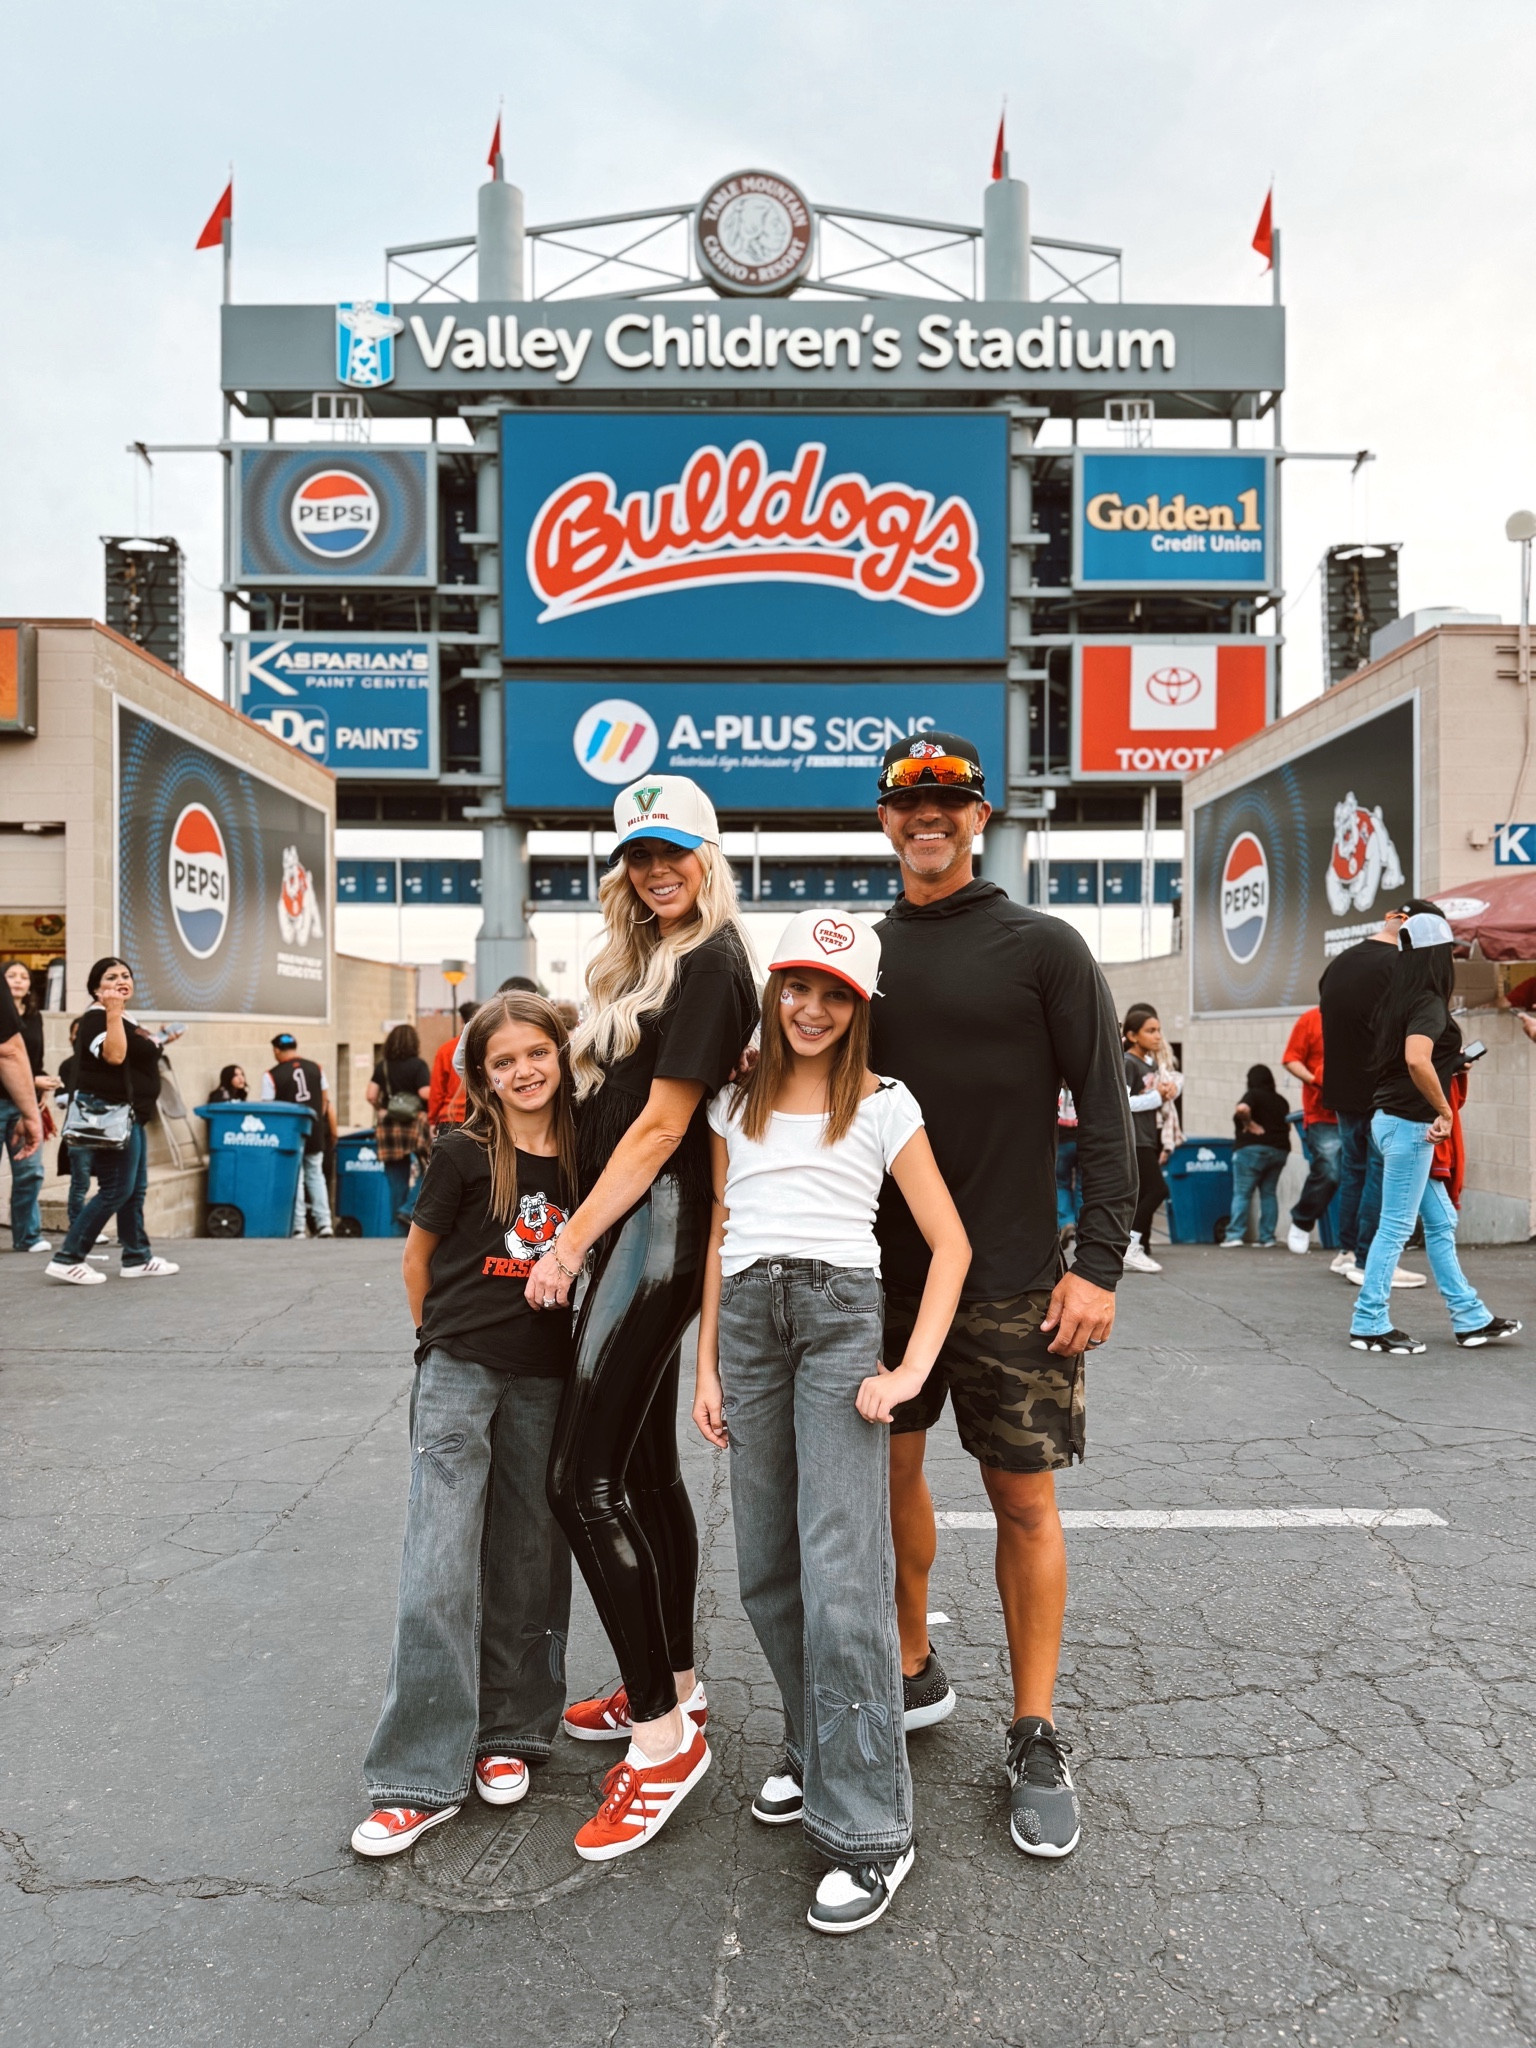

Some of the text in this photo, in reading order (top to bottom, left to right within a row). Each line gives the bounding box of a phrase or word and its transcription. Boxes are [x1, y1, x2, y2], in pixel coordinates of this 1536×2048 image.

[410, 313, 1176, 382] Valley Children's Stadium
[299, 505, 372, 522] PEPSI
[526, 439, 985, 624] Bulldogs
[1151, 533, 1262, 553] Credit Union
[305, 676, 429, 689] PAINT CENTER
[336, 727, 418, 750] PAINTS
[667, 714, 818, 752] A-PLUS
[627, 813, 670, 828] VALLEY GIRL
[174, 858, 226, 903] PEPSI
[1224, 880, 1265, 914] PEPSI
[819, 928, 848, 942] FRESNO
[819, 935, 843, 948] STATE
[293, 1068, 311, 1102] 1
